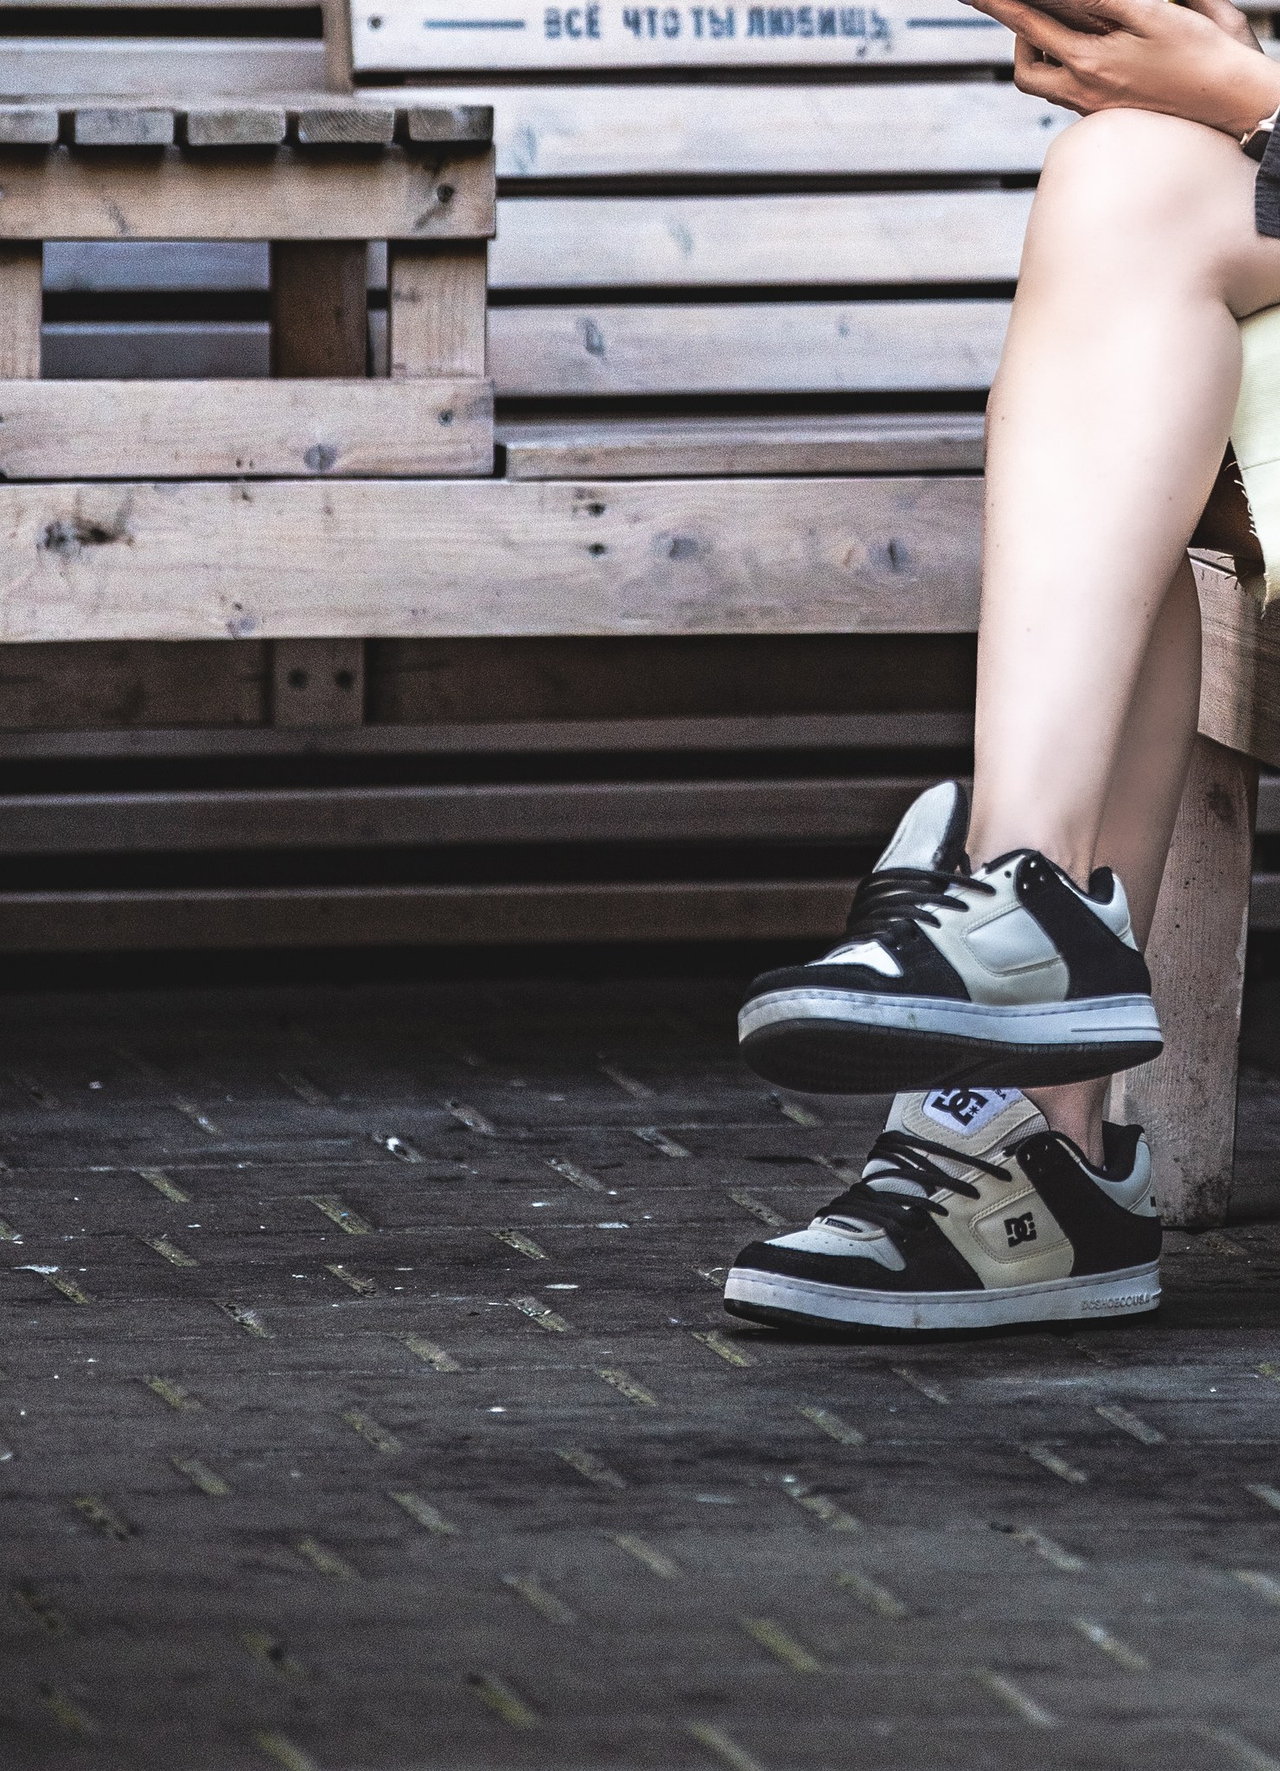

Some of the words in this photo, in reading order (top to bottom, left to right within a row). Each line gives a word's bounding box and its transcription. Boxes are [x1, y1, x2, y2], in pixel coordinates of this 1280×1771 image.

[543, 0, 601, 40] ВСЁ
[622, 5, 679, 39] ЧТО
[690, 5, 735, 39] ТЫ
[1003, 1211, 1037, 1248] DC
